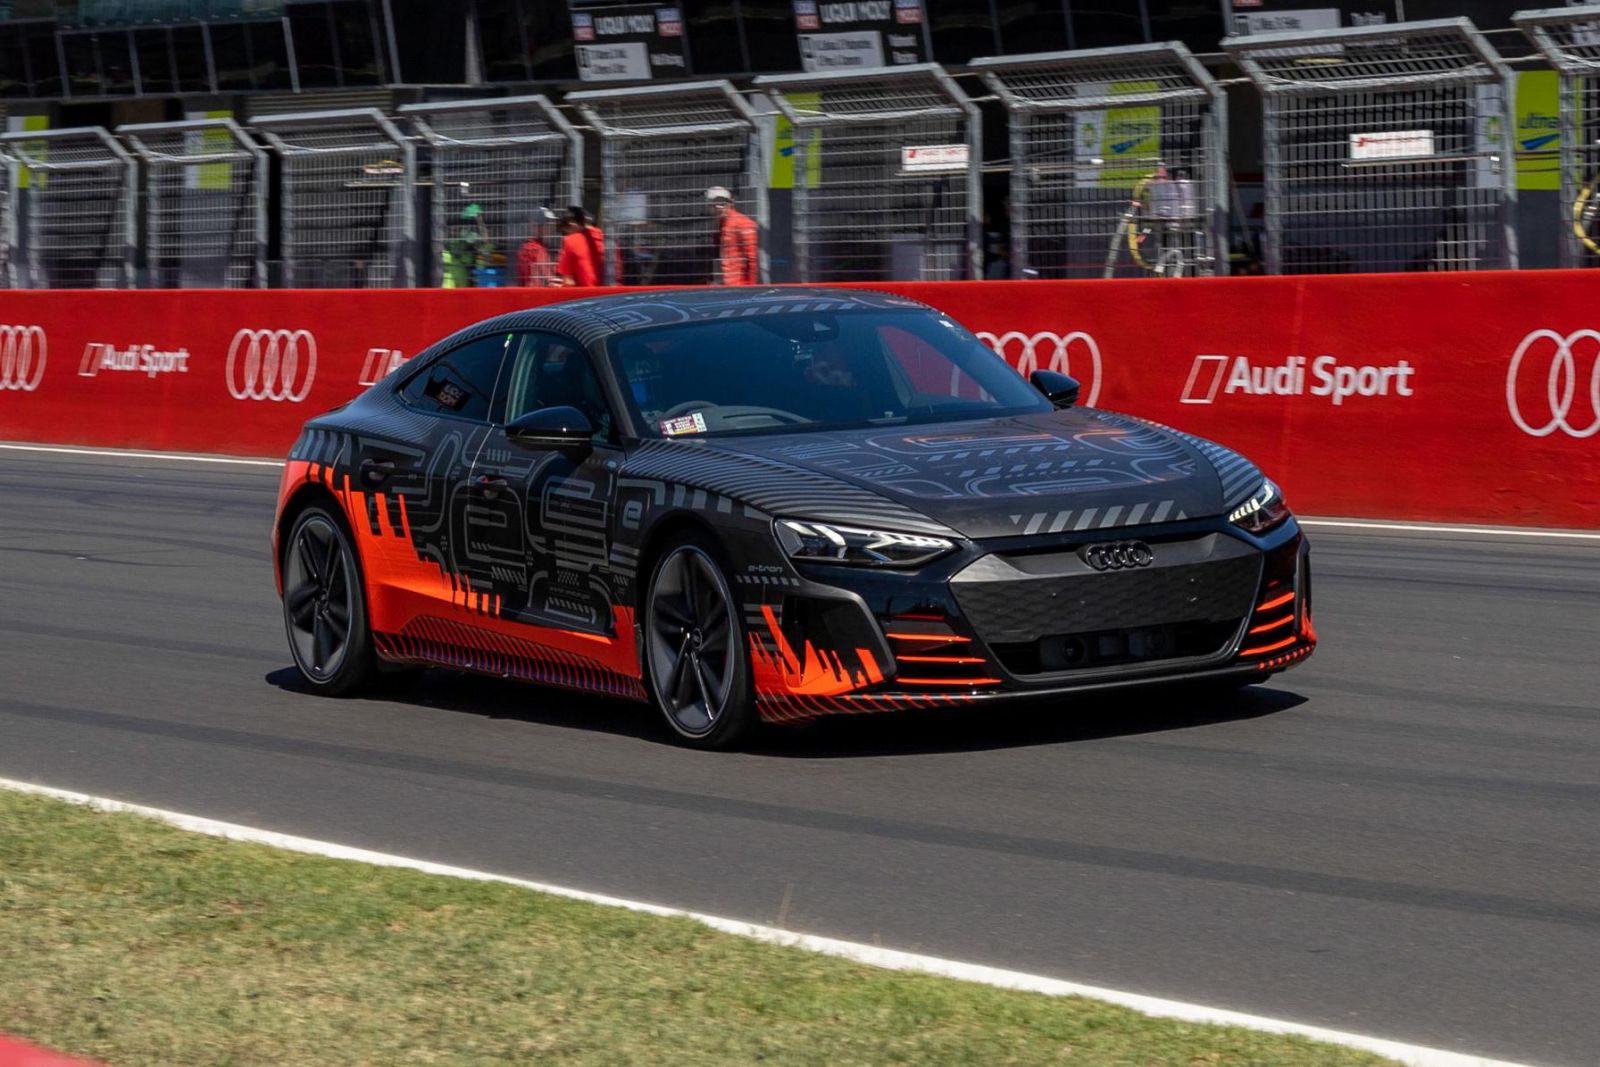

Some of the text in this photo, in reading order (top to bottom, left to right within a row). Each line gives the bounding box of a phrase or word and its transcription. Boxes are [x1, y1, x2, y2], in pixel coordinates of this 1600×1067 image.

[100, 344, 190, 378] Audi Sport
[1224, 355, 1415, 405] Audi Sport
